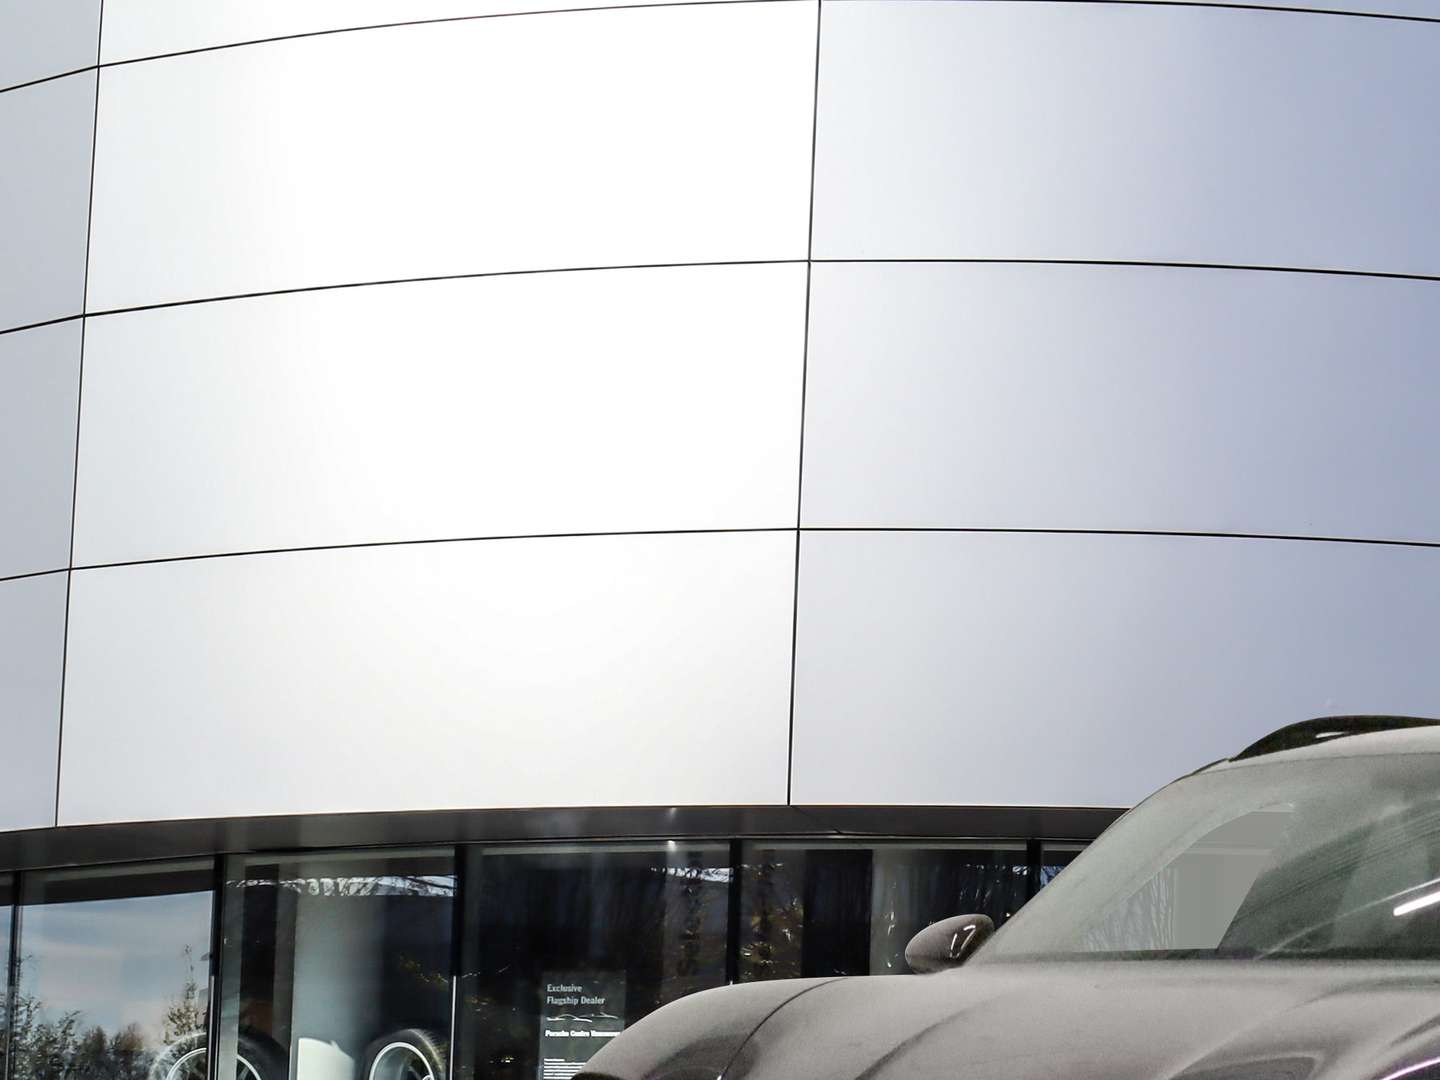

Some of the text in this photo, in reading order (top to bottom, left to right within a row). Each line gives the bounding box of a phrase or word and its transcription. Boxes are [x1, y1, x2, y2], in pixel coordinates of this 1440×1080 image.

[546, 983, 583, 993] Exclusive
[546, 995, 606, 1006] Flagship Dealer
